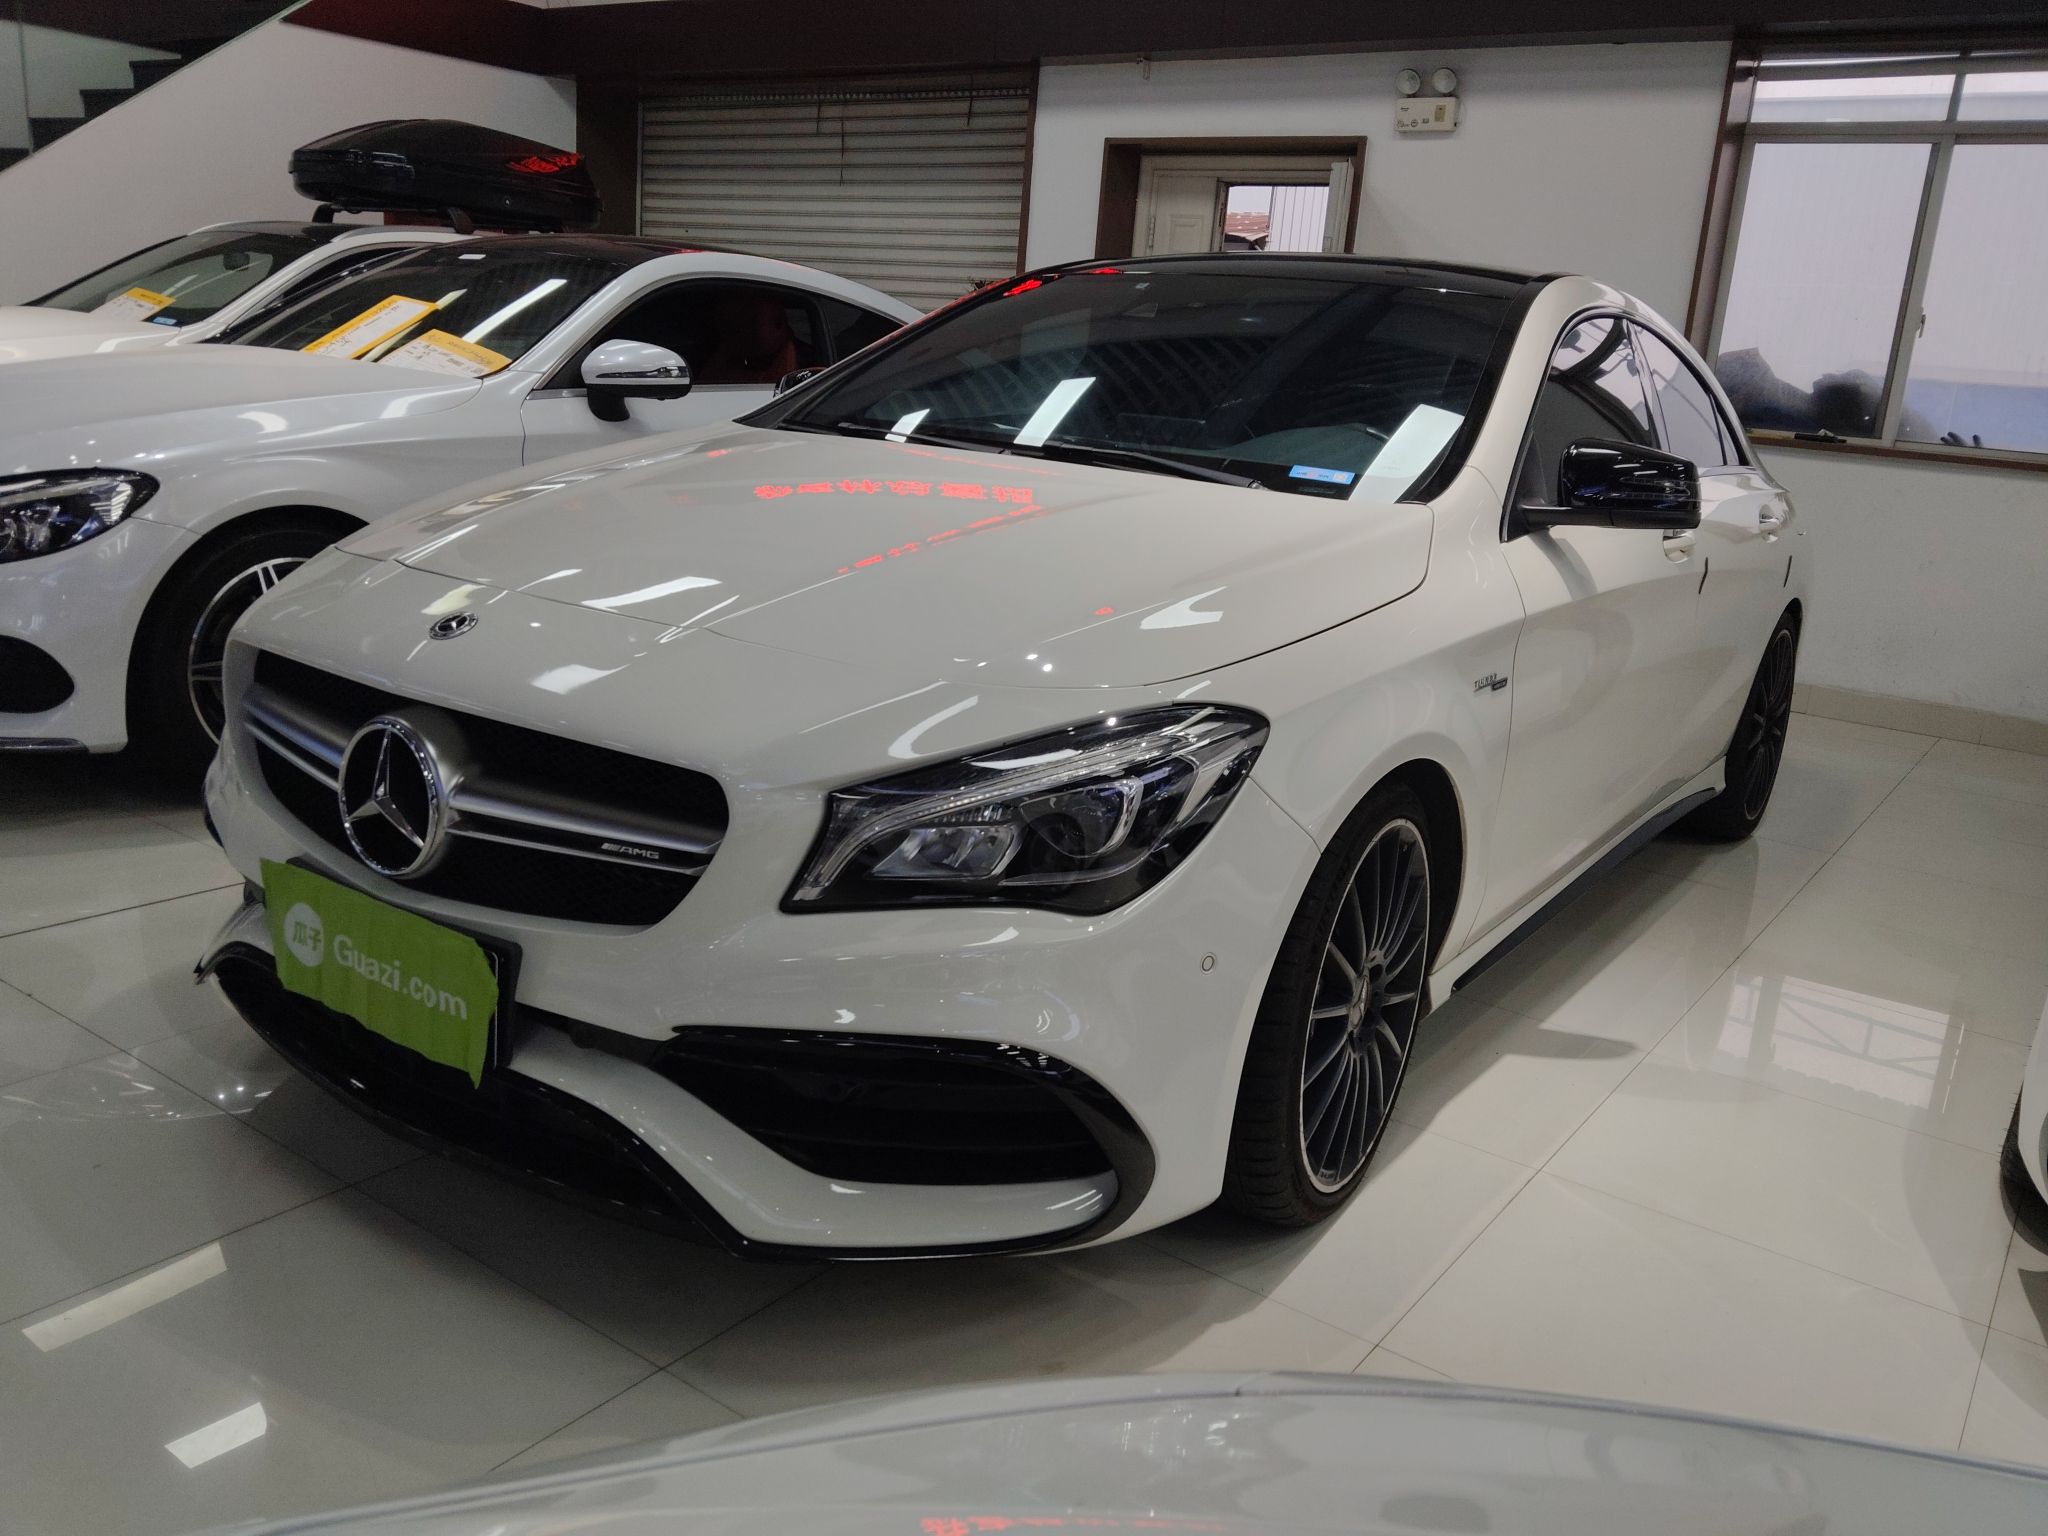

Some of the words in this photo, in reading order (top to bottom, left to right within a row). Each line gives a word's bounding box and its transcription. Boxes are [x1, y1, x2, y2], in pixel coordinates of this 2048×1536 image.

[619, 846, 660, 859] AMG
[292, 920, 322, 951] 瓜子
[333, 934, 468, 1020] Guazi.com
